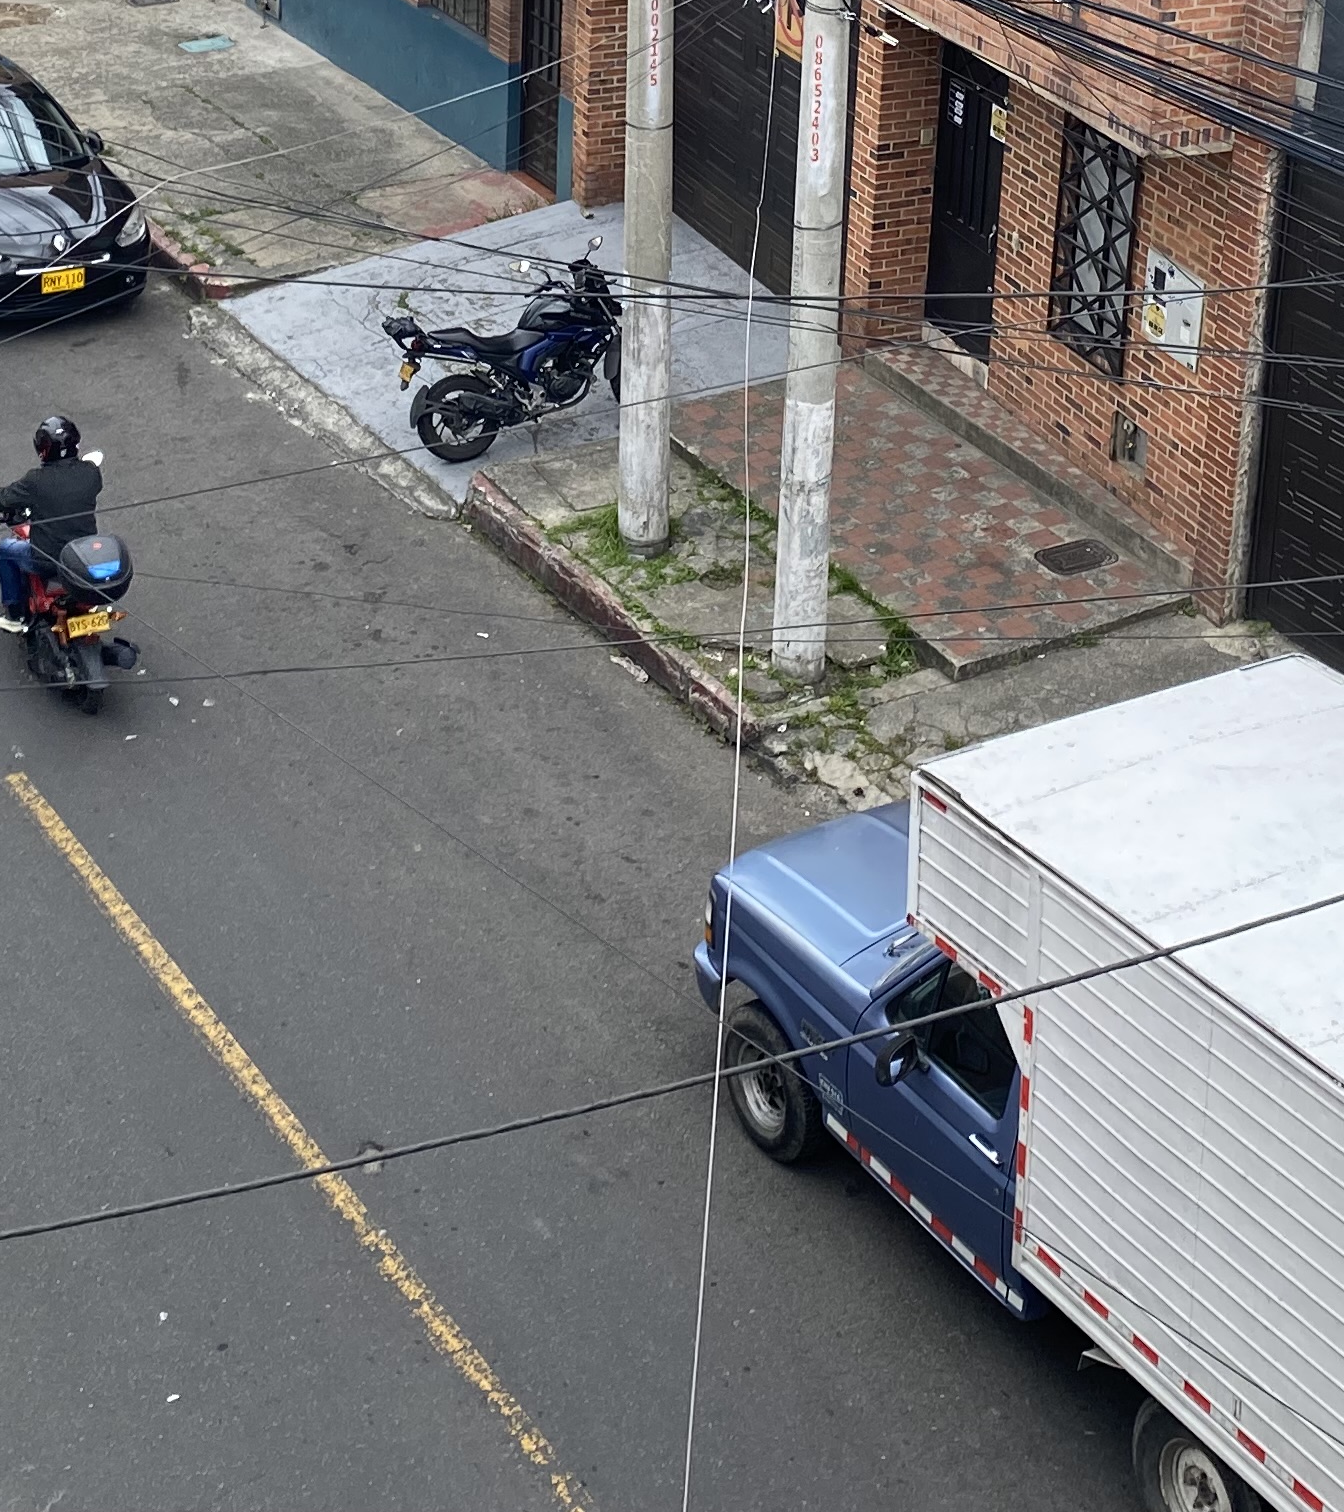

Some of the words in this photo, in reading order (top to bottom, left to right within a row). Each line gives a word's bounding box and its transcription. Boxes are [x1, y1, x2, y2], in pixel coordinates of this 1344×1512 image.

[810, 34, 824, 163] 08652403
[43, 274, 62, 289] RNY
[65, 271, 84, 286] 110
